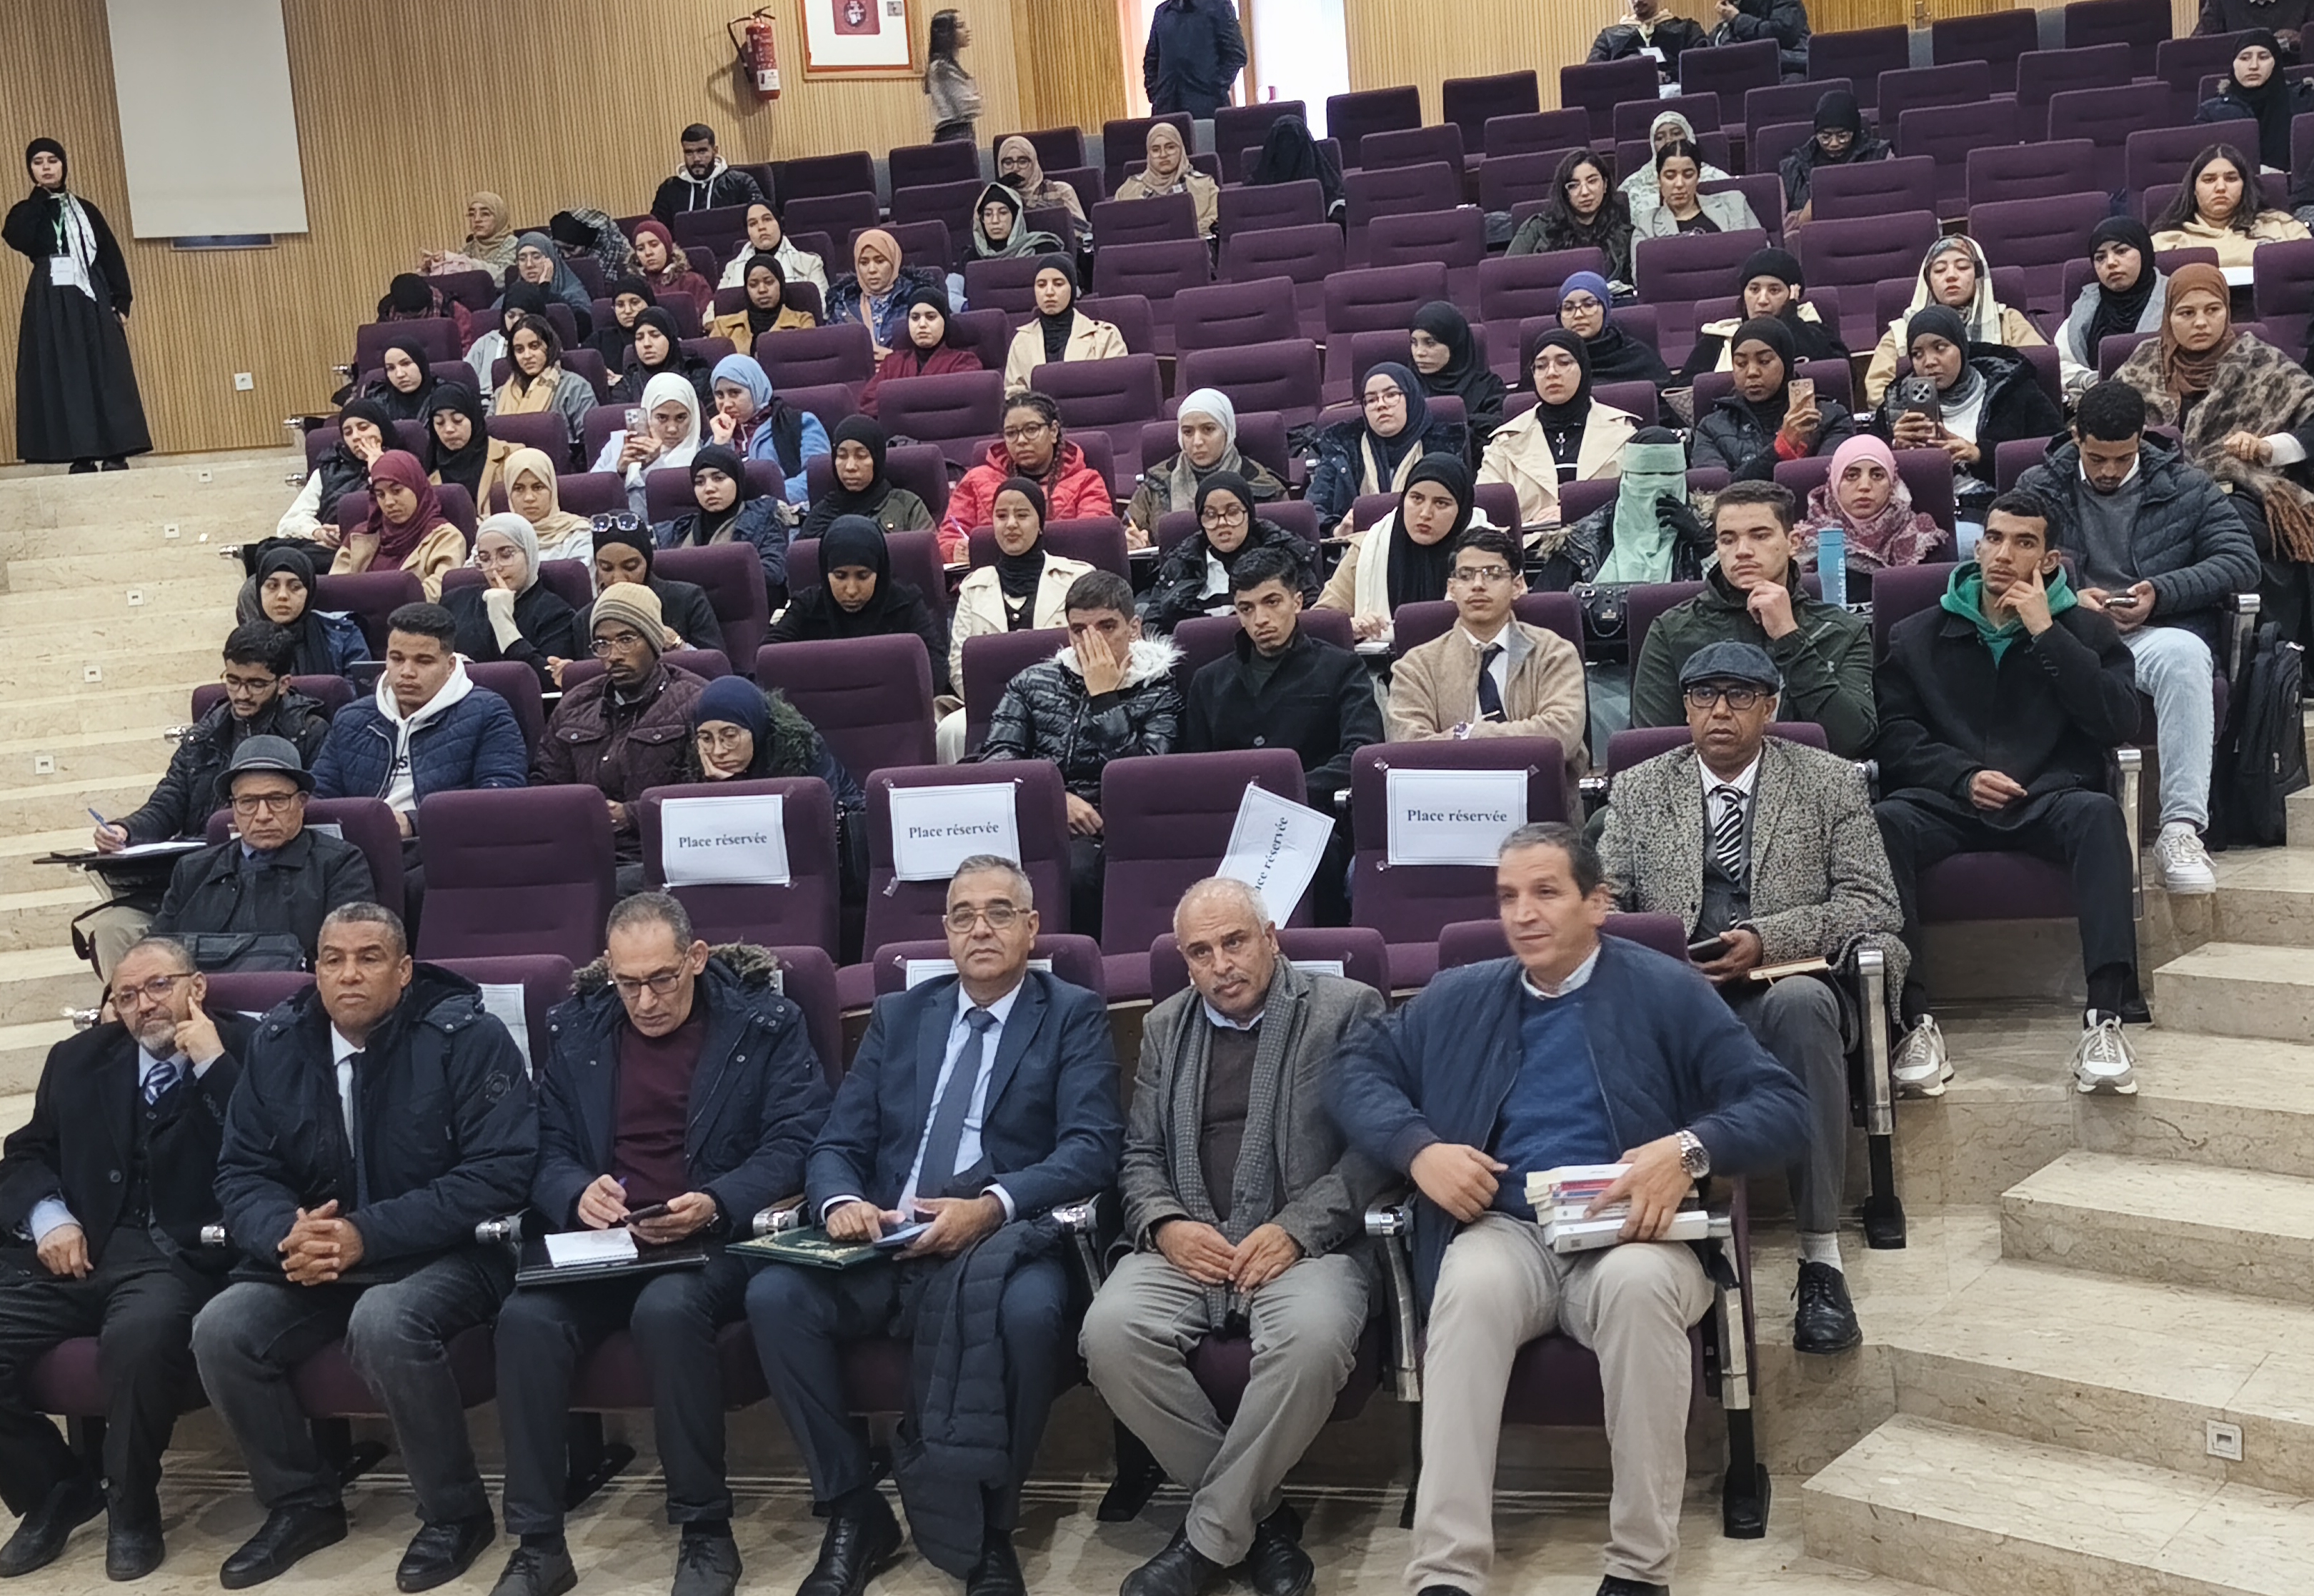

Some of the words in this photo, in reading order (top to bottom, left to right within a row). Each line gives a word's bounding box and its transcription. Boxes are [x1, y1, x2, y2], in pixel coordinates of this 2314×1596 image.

[1407, 809, 1444, 822] Place
[1449, 809, 1507, 822] réservée
[909, 827, 942, 839] Place
[947, 822, 999, 836] réservée
[679, 836, 712, 848] Place
[715, 832, 768, 846] réservée
[1255, 872, 1267, 891] ace
[1264, 817, 1288, 869] réservée
